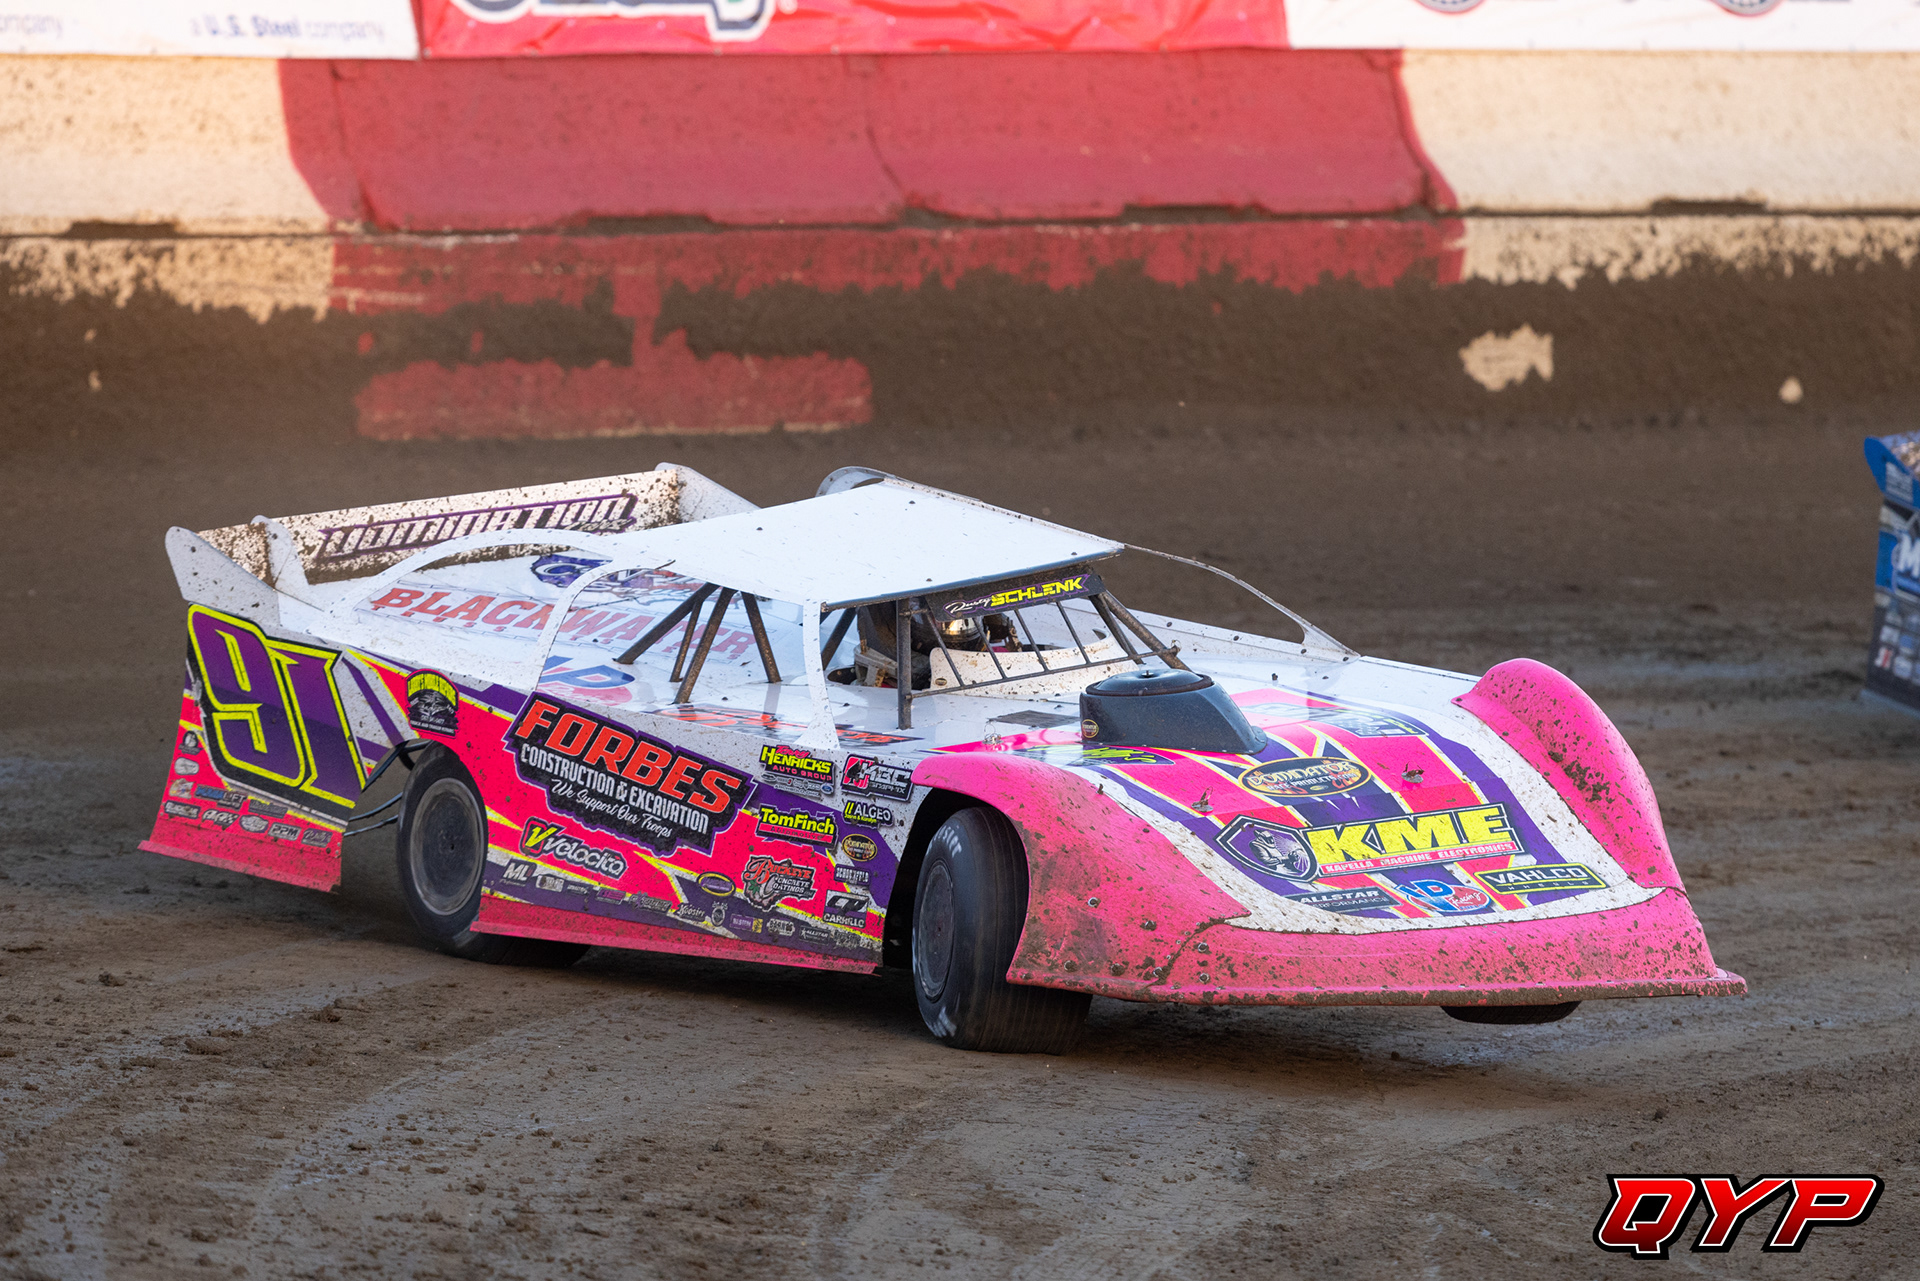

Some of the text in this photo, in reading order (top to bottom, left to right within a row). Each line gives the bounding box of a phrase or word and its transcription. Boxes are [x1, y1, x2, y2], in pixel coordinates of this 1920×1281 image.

[990, 577, 1083, 607] SCHLENK
[188, 604, 366, 809] 91
[515, 699, 741, 813] FORBES
[760, 746, 832, 774] HENRICKS
[772, 764, 799, 776] AUTO
[800, 769, 833, 783] GROUP
[1246, 761, 1353, 786] DOMINATOR
[521, 743, 710, 835] CONSTRUCTION & EXCAVATION
[551, 778, 674, 839] We Support Our Troops
[761, 807, 835, 834] TomFinch
[853, 804, 892, 822] ALGEO
[1306, 806, 1511, 865] KME
[742, 858, 812, 884] BUCKEYE
[1325, 841, 1513, 874] KAPELLA MACHINE ELECTRONICS
[1487, 866, 1587, 886] VAHLCO
[1300, 889, 1380, 904] ALLSTAR
[1310, 897, 1389, 909] ERFORMANCE
